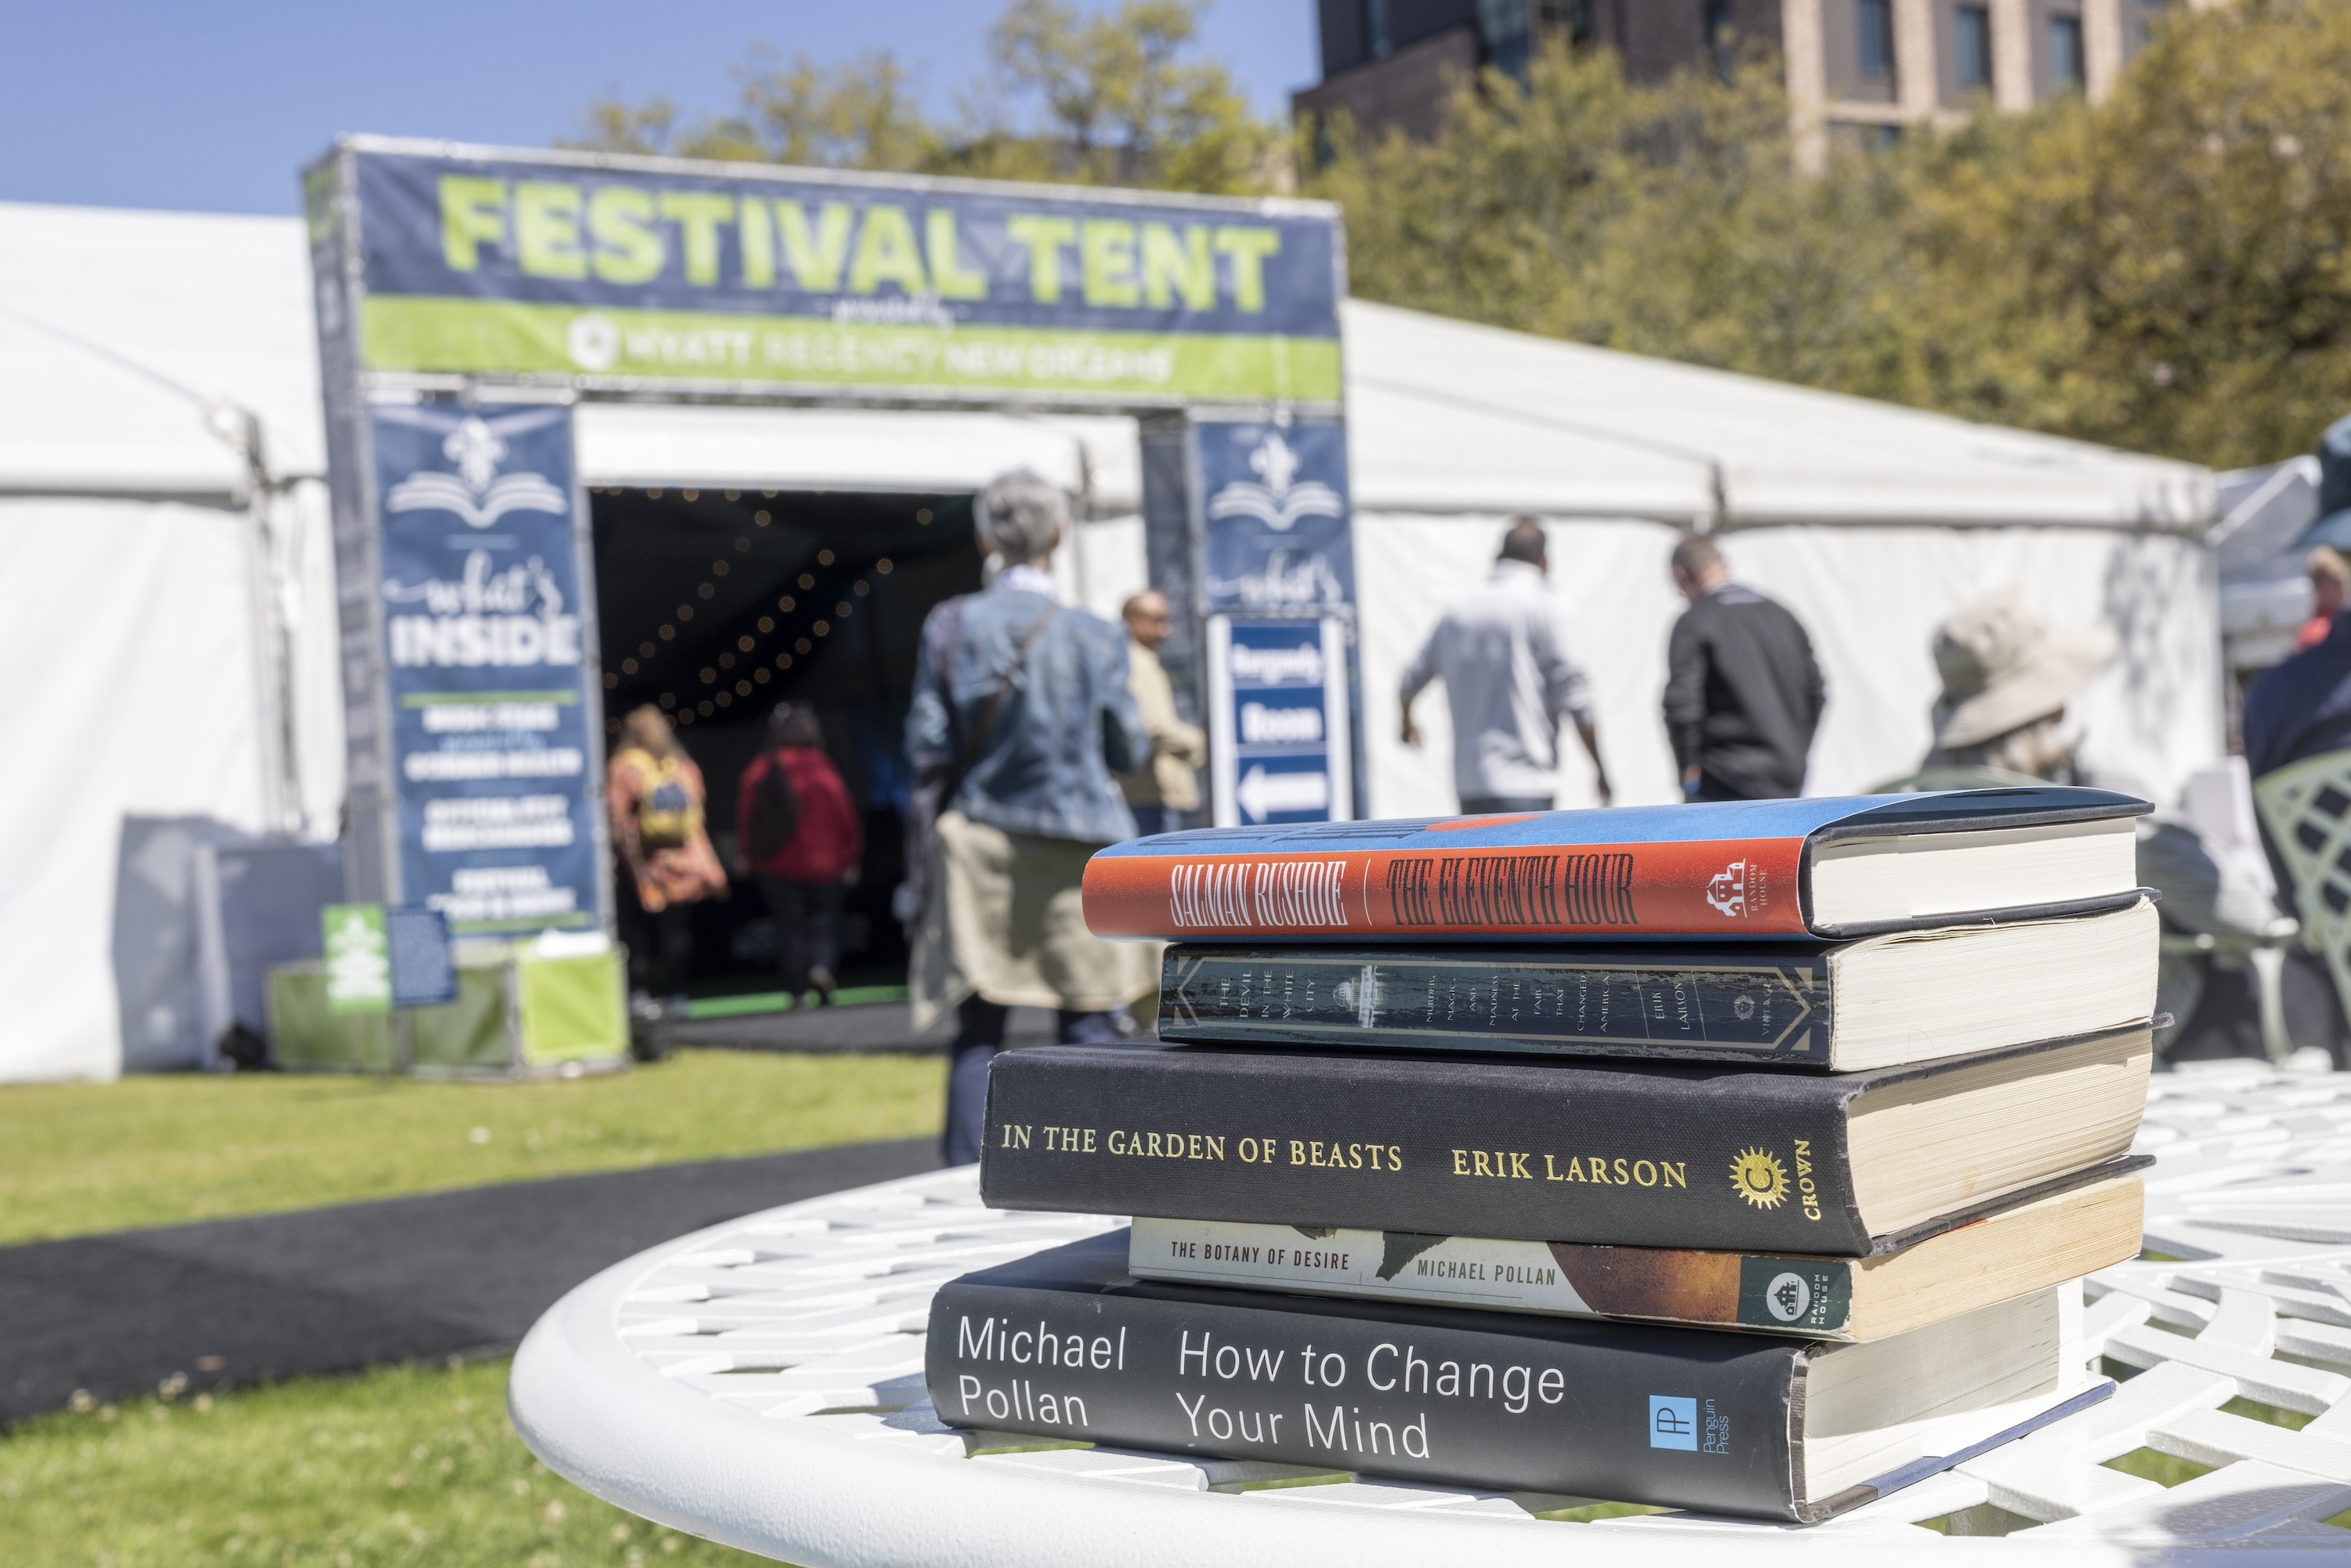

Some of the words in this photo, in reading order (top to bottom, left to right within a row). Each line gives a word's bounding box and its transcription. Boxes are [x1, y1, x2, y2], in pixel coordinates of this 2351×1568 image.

[437, 173, 989, 301] FESTIVAL
[1008, 213, 1281, 314] TENT
[625, 326, 755, 368] HYATT
[763, 331, 939, 374] REGENCY
[944, 339, 1025, 378] NEW
[1028, 344, 1175, 383] ORLEANS
[389, 614, 581, 668] INSIDE
[1170, 862, 1252, 927] SALMAN
[1255, 860, 1349, 927] RUSHDIE
[1386, 857, 1436, 926] THE
[1440, 854, 1561, 925] ELEVENTH
[1565, 853, 1639, 925] HOUR
[1749, 864, 1759, 911] RANDOM
[1759, 868, 1768, 906] HOUSE
[1219, 976, 1231, 1009] THE
[1239, 969, 1252, 1018] DEVIL
[1263, 969, 1273, 995] THE
[1282, 970, 1295, 1019] WHITE
[1305, 978, 1316, 1012] CITY
[1425, 974, 1436, 1023] MURDER,
[1447, 977, 1457, 1021] MAGIC,
[1488, 975, 1498, 1026] MADNESS
[1534, 988, 1542, 1016] FAIR
[1556, 987, 1564, 1016] THAT
[1577, 974, 1587, 1031] CHANGED
[1599, 975, 1610, 1033] AMERICA
[1651, 991, 1665, 1019] ERIK
[1674, 982, 1690, 1030] LARSON
[1261, 1005, 1270, 1018] IN
[1511, 1009, 1519, 1022] AT
[1001, 1124, 1032, 1150] IN
[1043, 1126, 1097, 1153] THE
[1107, 1130, 1226, 1161] GARDEN
[1238, 1136, 1277, 1164] OF
[1289, 1140, 1403, 1171] BEASTS
[1451, 1149, 1534, 1179] ERIK
[1544, 1154, 1686, 1190] LARSON
[1794, 1139, 1821, 1222] CROWN
[1171, 1240, 1197, 1258] THE
[1204, 1244, 1259, 1264] BOTANY
[1267, 1248, 1285, 1266] OF
[1293, 1250, 1349, 1270] DESIRE
[1417, 1258, 1486, 1281] MICHAEL
[1494, 1264, 1556, 1287] POLLAN
[1810, 1274, 1820, 1324] RANDOM
[1819, 1275, 1828, 1325] HOUSE
[958, 1316, 1127, 1371] Michael
[1179, 1330, 1285, 1382] How
[1301, 1344, 1346, 1387] to
[1366, 1343, 1565, 1414] Change
[958, 1374, 1089, 1427] Pollan
[1176, 1392, 1284, 1445] Your
[1304, 1402, 1430, 1459] Mind
[1703, 1398, 1719, 1454] Penguin
[1716, 1415, 1730, 1454] Press
